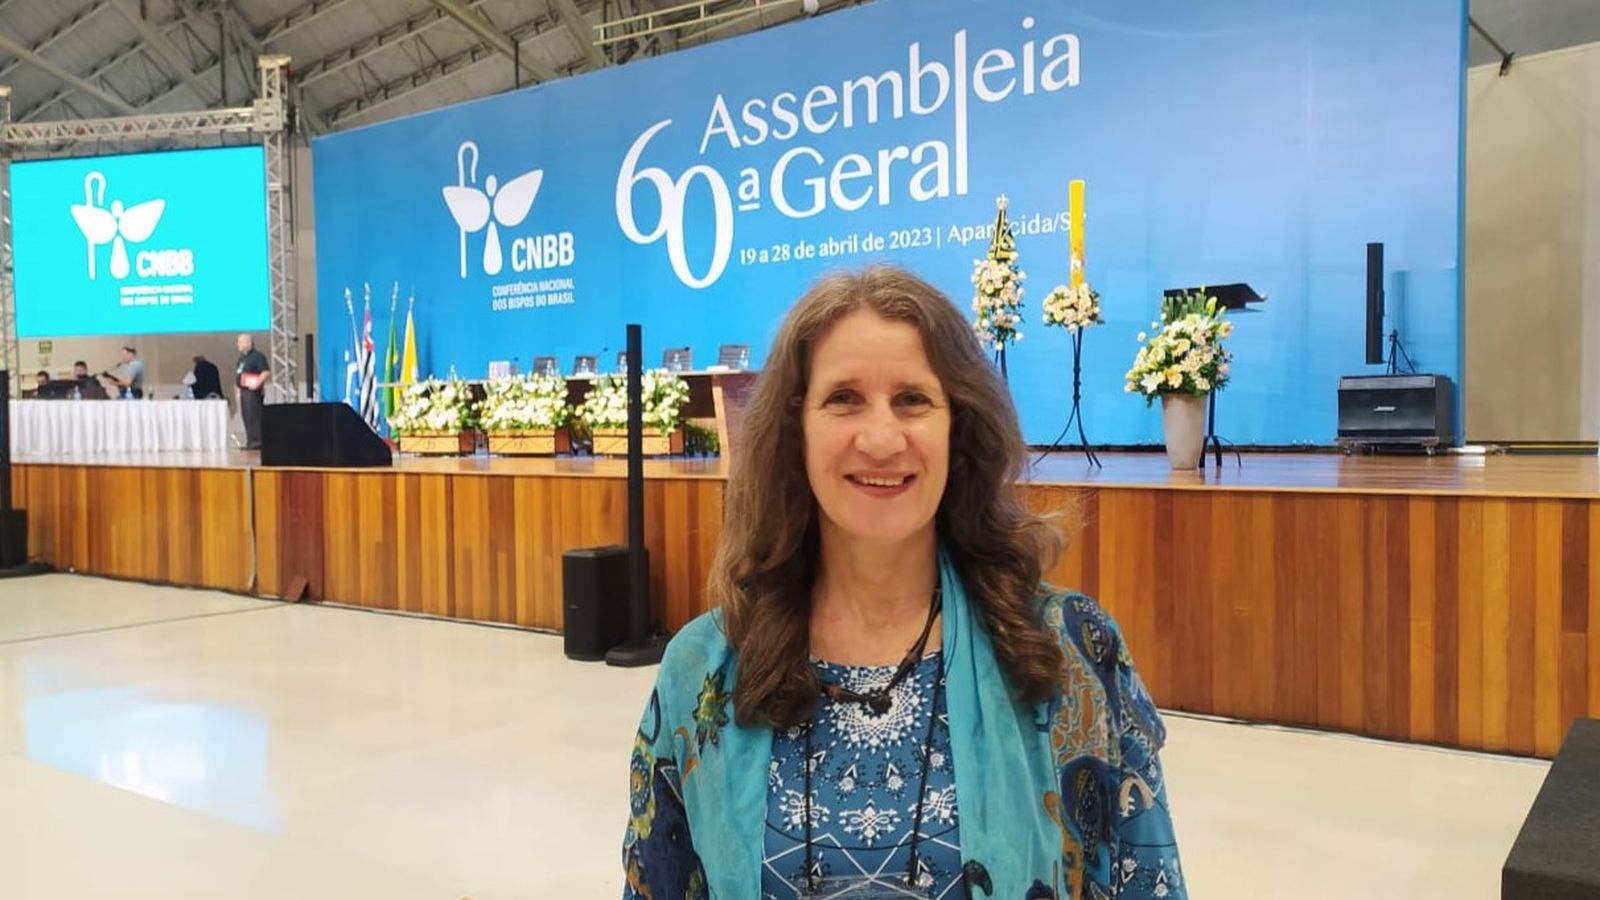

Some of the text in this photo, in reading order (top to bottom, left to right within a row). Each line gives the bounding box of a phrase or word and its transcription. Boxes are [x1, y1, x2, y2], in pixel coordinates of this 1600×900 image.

[699, 17, 1081, 154] Assembleia
[770, 118, 969, 219] Geral
[136, 248, 194, 278] CNBB
[511, 232, 575, 272] CNBB
[740, 248, 756, 264] 19
[759, 250, 769, 263] a
[771, 244, 790, 262] 28
[794, 240, 816, 259] de
[819, 233, 858, 257] abril
[862, 231, 884, 252] de
[889, 226, 932, 249] 2023
[493, 292, 575, 311] DOS BISPOS DO BRASIL
